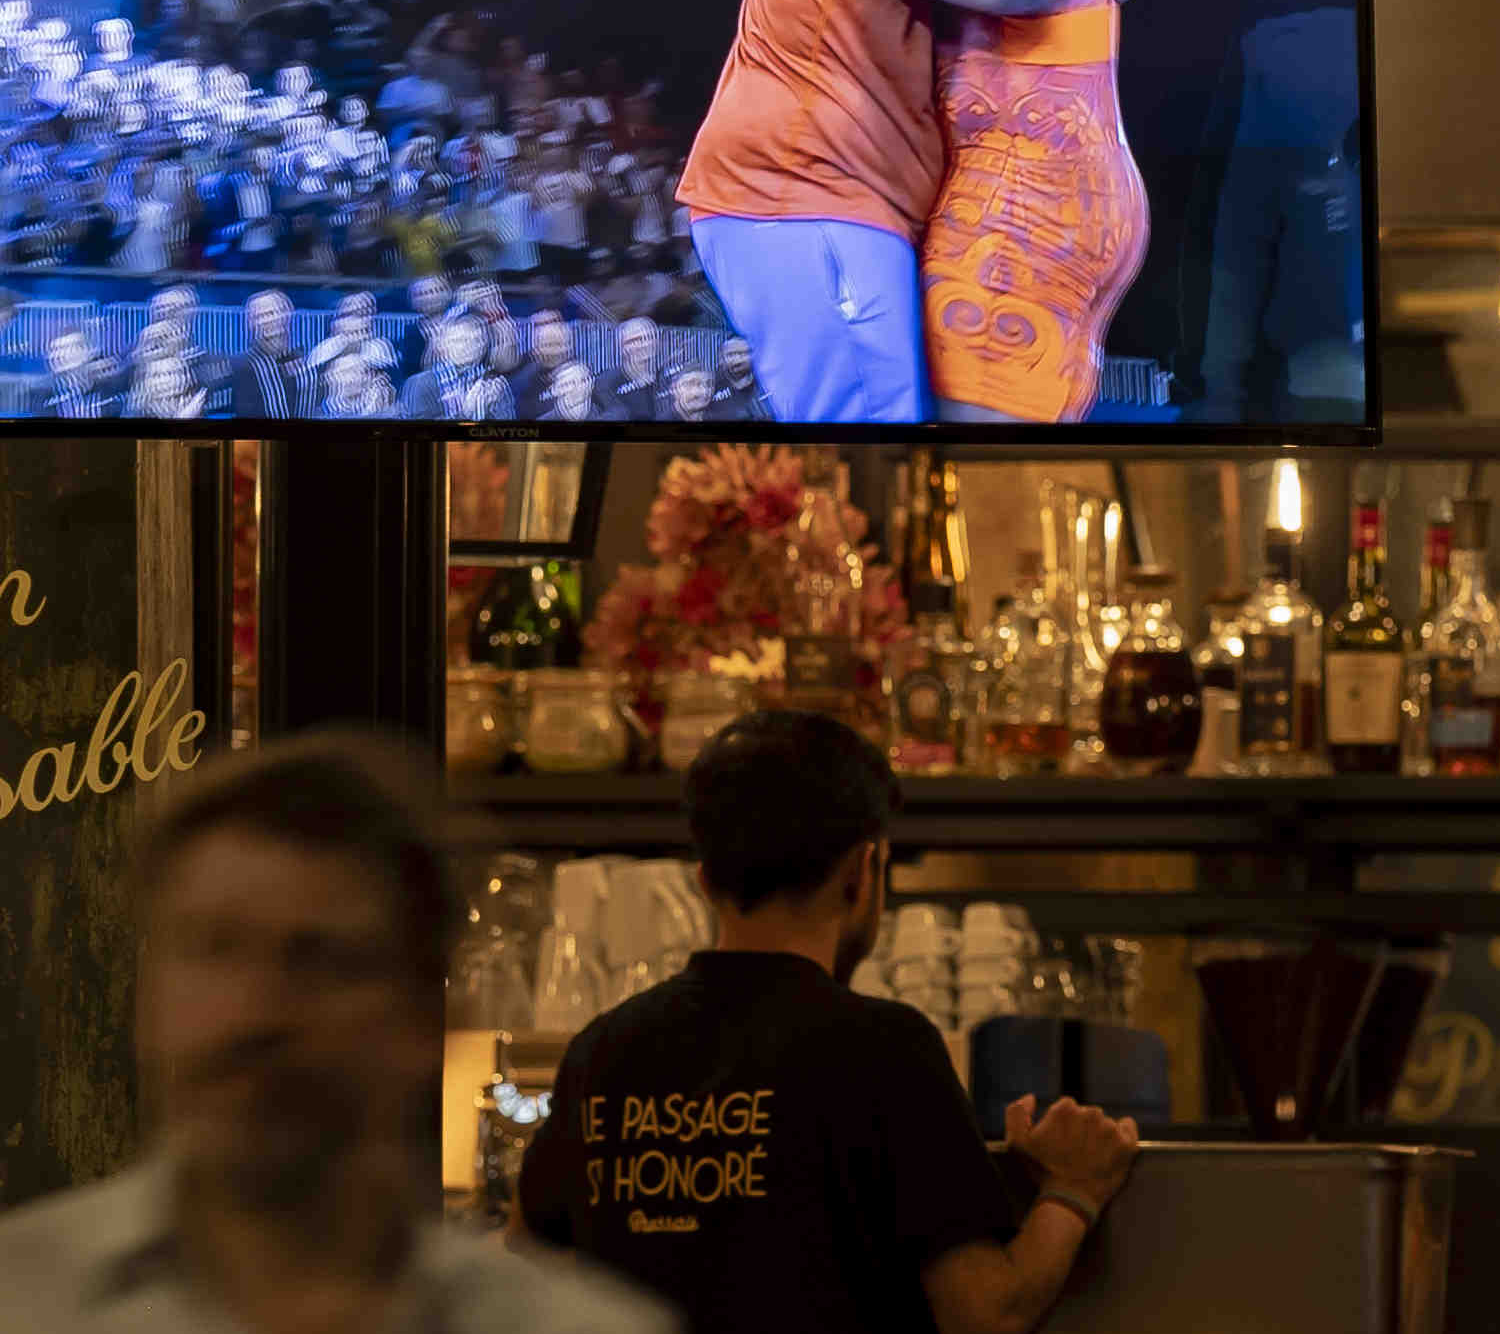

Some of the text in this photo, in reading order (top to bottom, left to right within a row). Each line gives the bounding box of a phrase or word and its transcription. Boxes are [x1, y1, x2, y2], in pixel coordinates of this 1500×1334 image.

[581, 1090, 775, 1145] LE PASSAGE
[614, 1143, 769, 1203] HONORÉ
